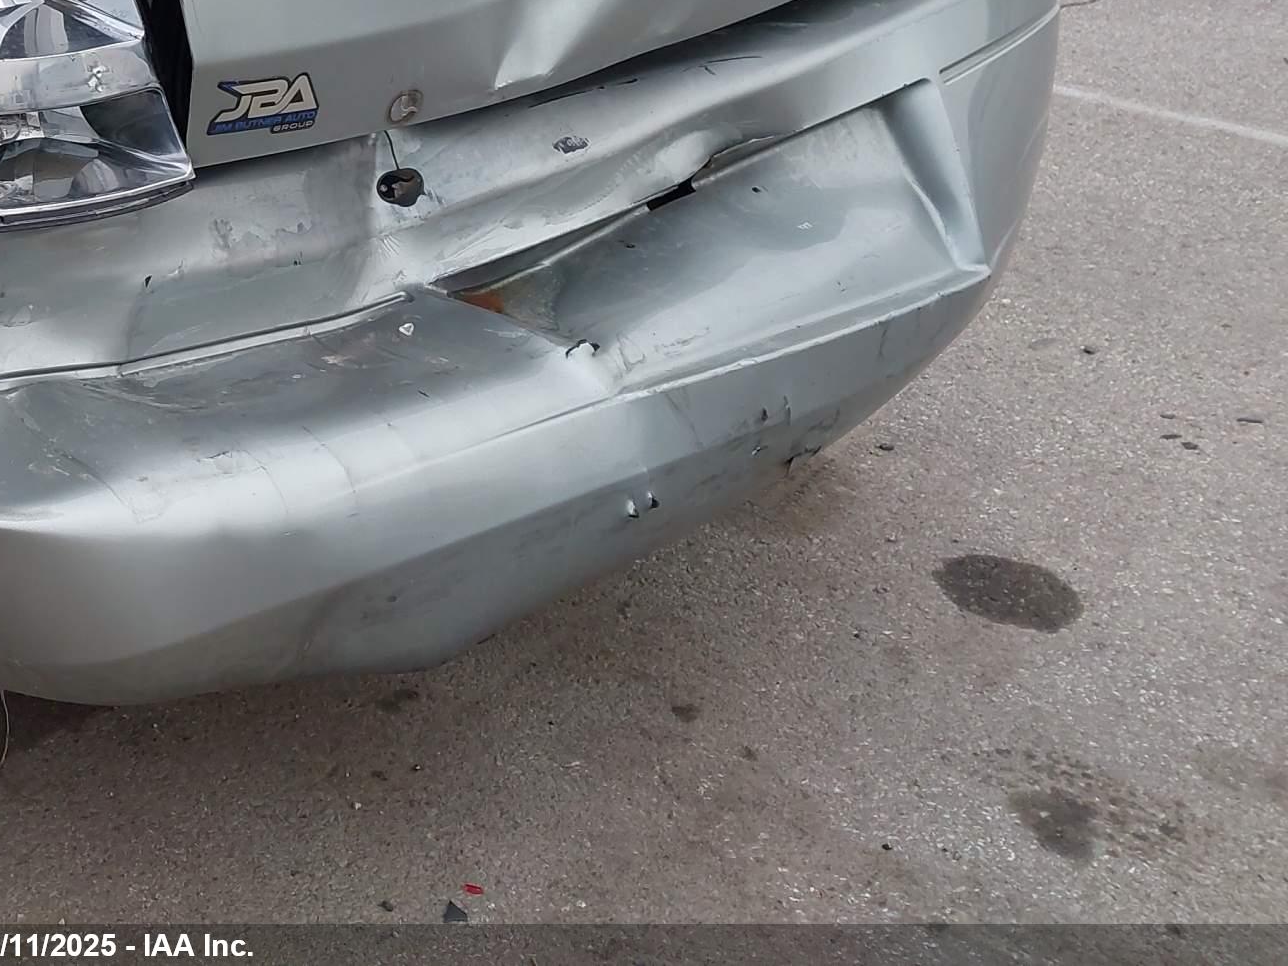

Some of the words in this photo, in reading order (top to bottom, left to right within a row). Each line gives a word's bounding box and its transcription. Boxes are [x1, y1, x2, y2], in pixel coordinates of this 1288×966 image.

[214, 74, 318, 123] JBA
[285, 111, 316, 123] AUTO
[272, 120, 314, 132] GROUP
